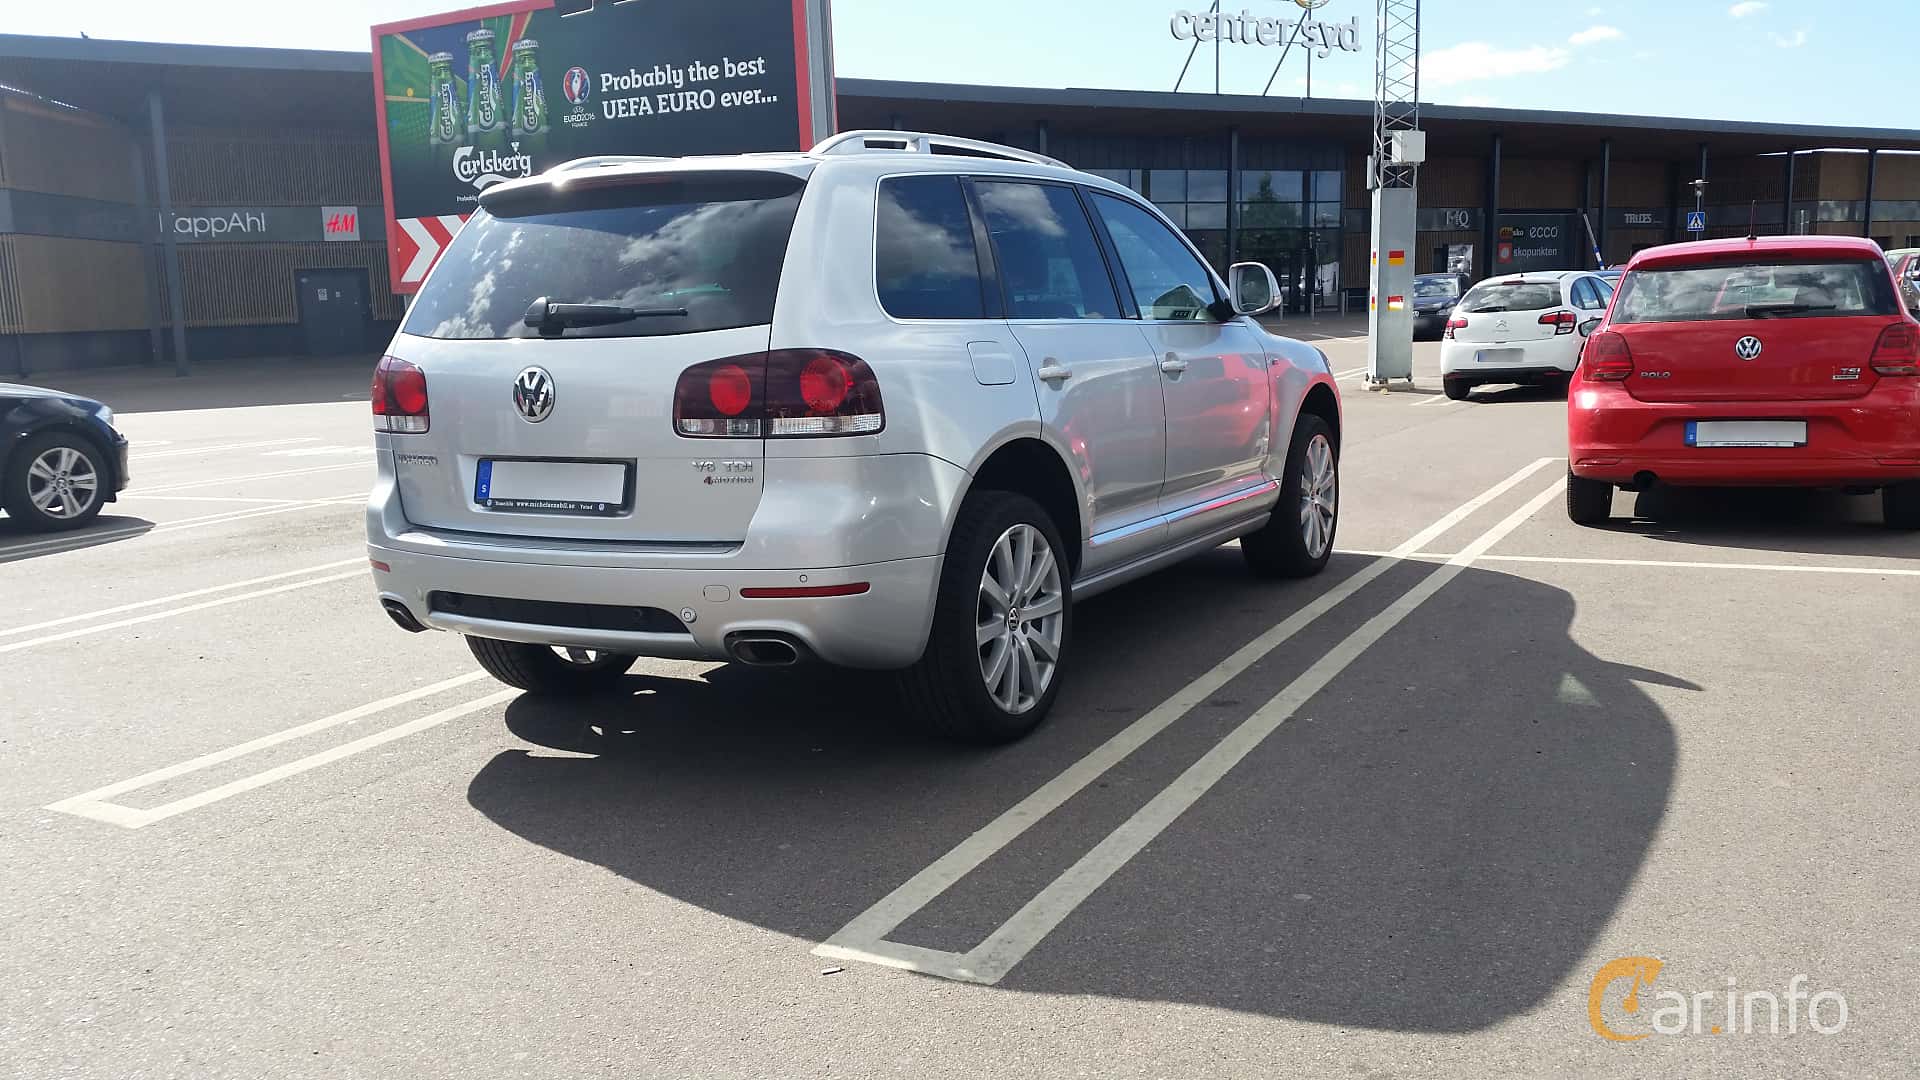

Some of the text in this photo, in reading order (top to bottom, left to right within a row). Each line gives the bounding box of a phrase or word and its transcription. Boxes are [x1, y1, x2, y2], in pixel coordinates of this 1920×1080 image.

[1171, 8, 1362, 58] center syd
[600, 56, 766, 92] Probably the best
[479, 63, 495, 129] Carlsberg
[523, 71, 538, 131] Carlsberg
[602, 89, 778, 119] UEFA EURO ever...
[453, 143, 531, 182] Carlsberg
[327, 212, 356, 233] H&M
[1529, 226, 1558, 239] ecco
[1513, 247, 1558, 258] skopunkten
[481, 484, 488, 493] S
